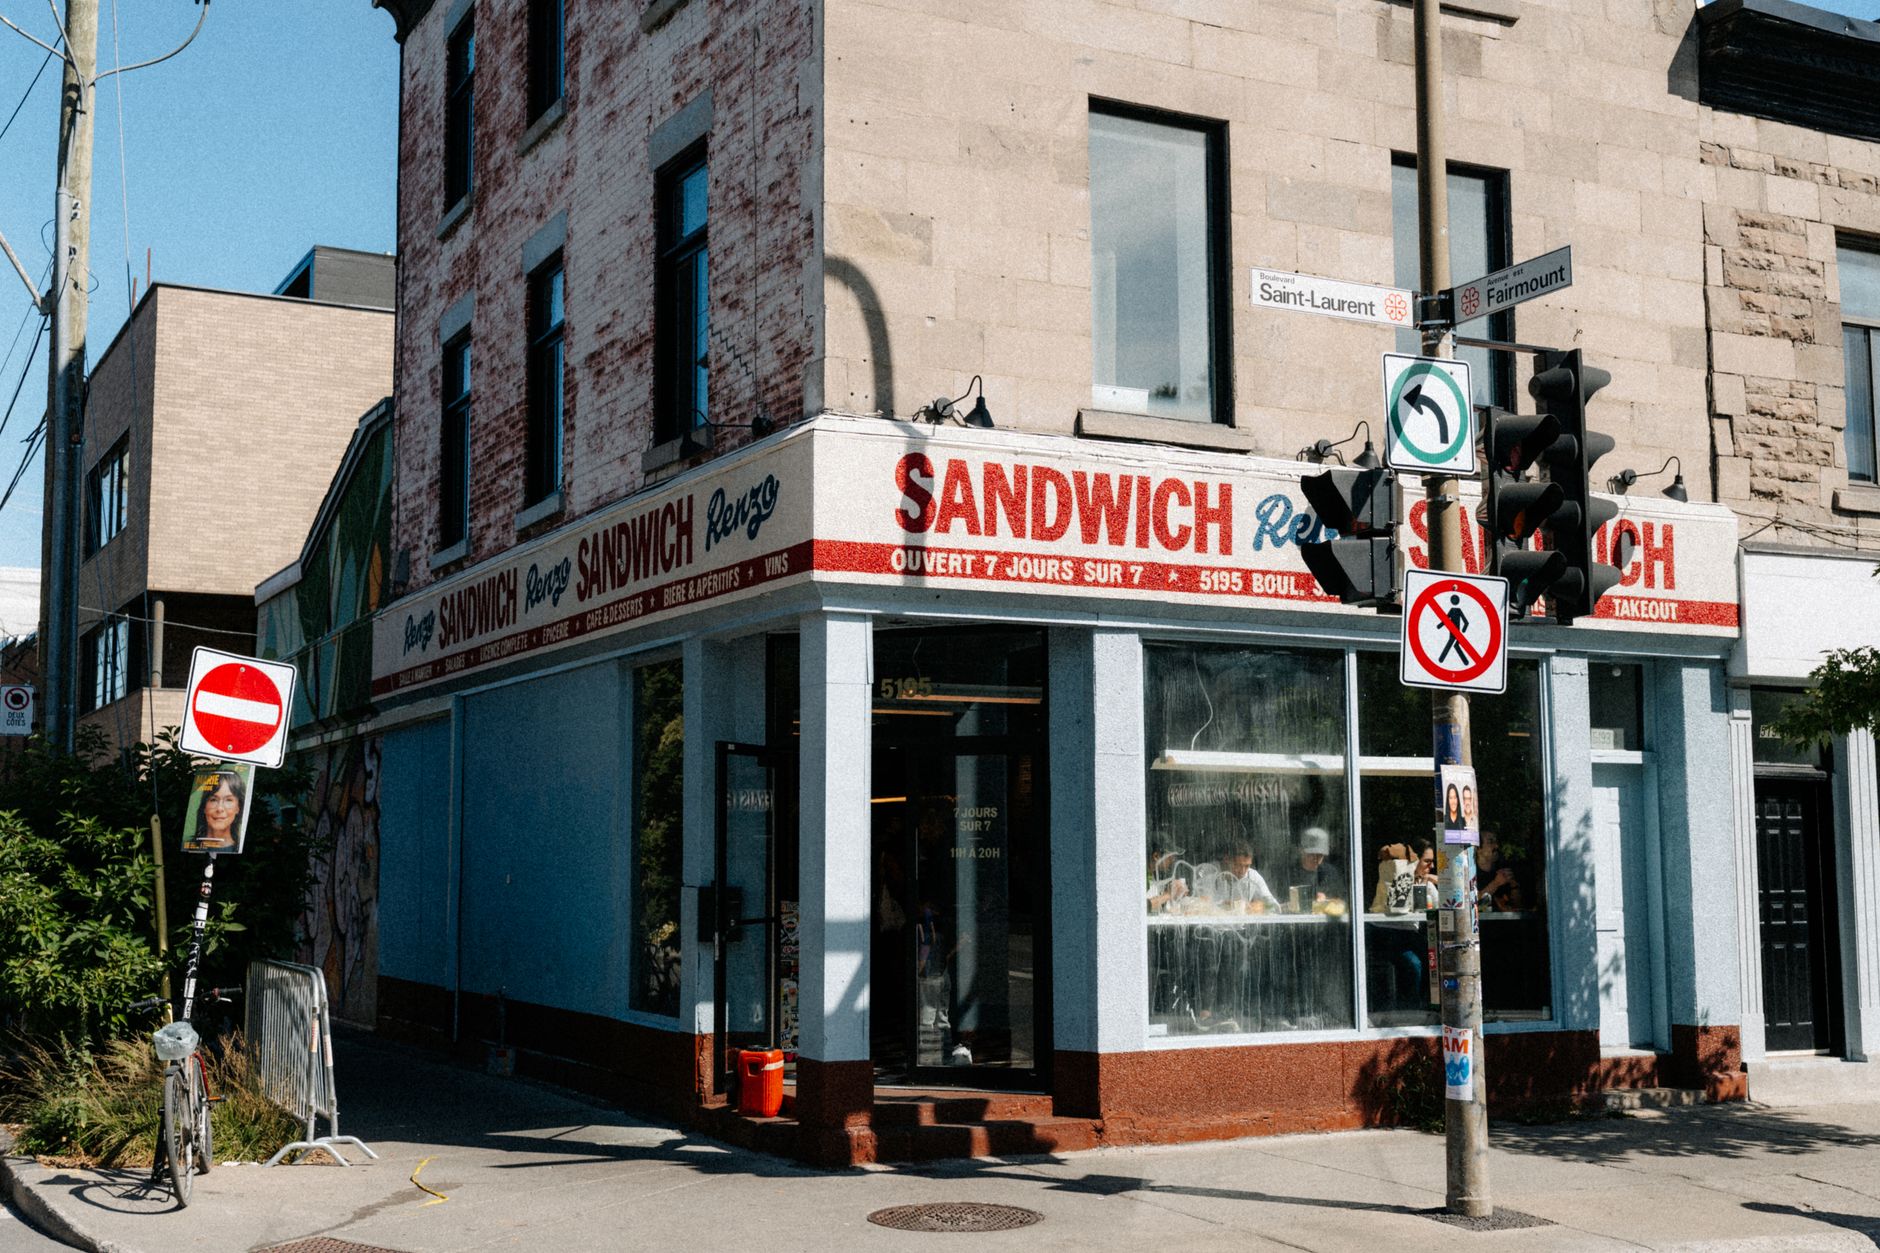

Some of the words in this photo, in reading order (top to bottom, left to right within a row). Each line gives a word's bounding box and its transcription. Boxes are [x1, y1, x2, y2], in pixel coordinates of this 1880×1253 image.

[1260, 272, 1295, 284] Boulevard
[1487, 274, 1509, 286] Avenue
[1512, 268, 1524, 277] est
[1487, 265, 1566, 307] Fairmount
[1260, 282, 1376, 316] Saint-Laurent
[894, 452, 1234, 556] SANDWICH
[403, 610, 436, 656] Renzo
[439, 567, 518, 650] SANDWICH
[525, 557, 572, 614] Renzo
[577, 494, 694, 602] SANDWICH
[705, 474, 780, 552] Renzo
[609, 596, 643, 623] DESSERTS
[687, 580, 695, 600] &
[696, 569, 740, 598] APÉRITIFS
[765, 552, 788, 577] VINS
[891, 548, 974, 577] OUVERT
[984, 555, 998, 577] 7
[1005, 555, 1074, 583] JOURS
[1083, 561, 1123, 585] SUR
[1130, 565, 1143, 585] 7
[1199, 570, 1243, 592] 5195
[1252, 573, 1305, 596] BOUL.
[1612, 599, 1679, 619] TAKEOUT
[881, 676, 932, 699] 5195
[8, 711, 25, 719] DEUX
[953, 807, 959, 818] 7
[962, 807, 998, 818] JOURS
[960, 821, 982, 831] SUR
[984, 820, 992, 831] 7
[950, 848, 965, 858] 11H
[978, 848, 1000, 858] 20H
